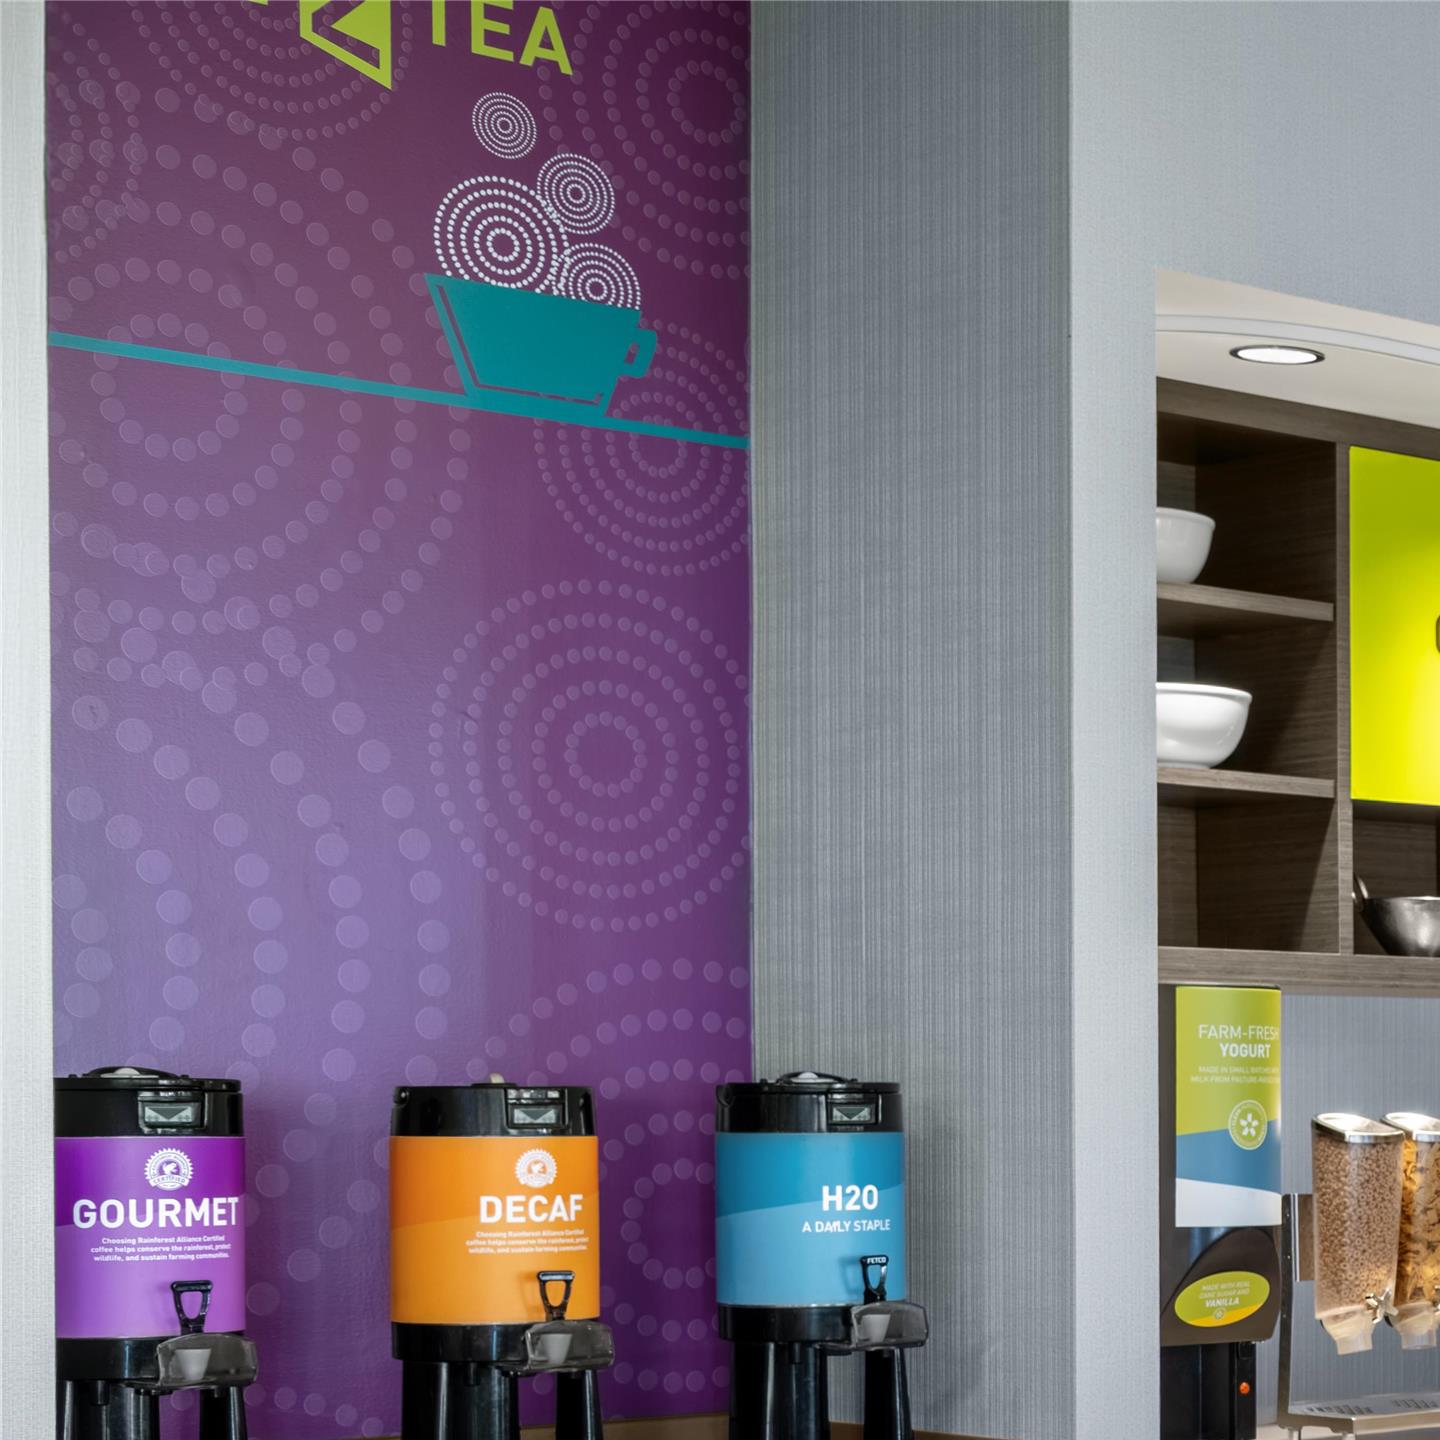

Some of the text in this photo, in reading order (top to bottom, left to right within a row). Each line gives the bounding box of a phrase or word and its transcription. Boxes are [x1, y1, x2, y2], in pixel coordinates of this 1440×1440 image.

[1220, 1043, 1272, 1058] YOGURT
[72, 1197, 240, 1230] GOURMET
[480, 1194, 584, 1223] DECAF
[802, 1221, 812, 1233] A
[853, 1219, 891, 1232] STAPLE
[102, 1237, 136, 1245] Choosing
[115, 1245, 136, 1253] helps
[169, 1253, 195, 1261] farming
[1205, 1297, 1240, 1307] VANILLA
